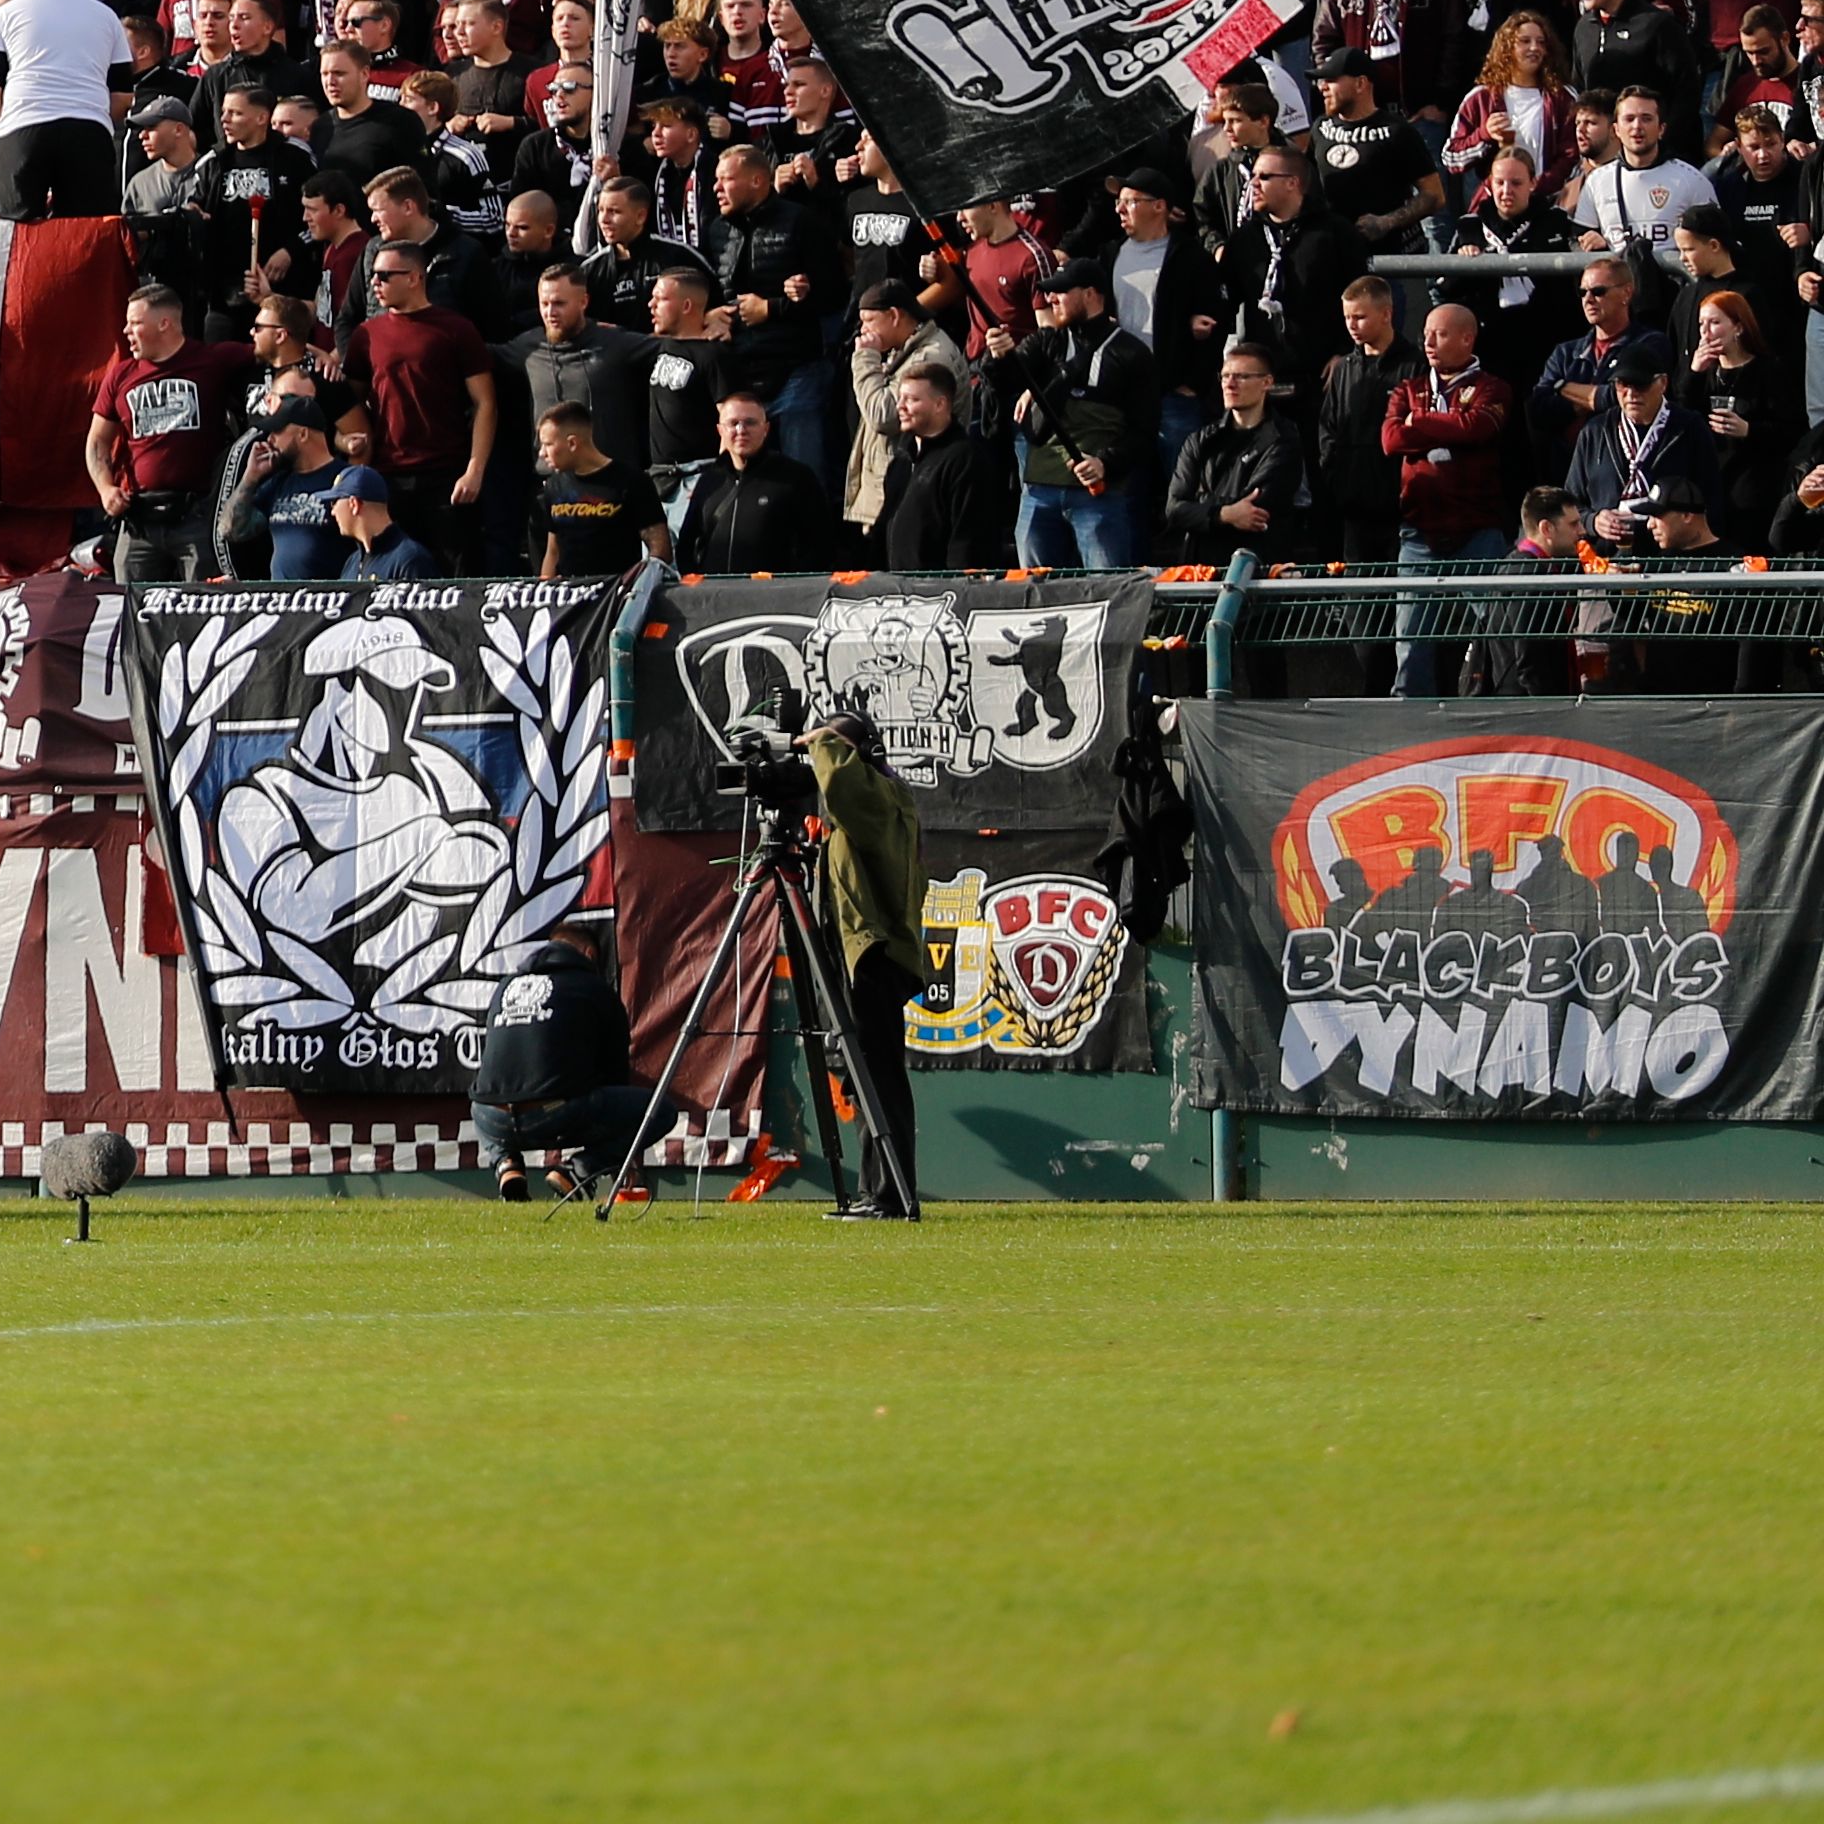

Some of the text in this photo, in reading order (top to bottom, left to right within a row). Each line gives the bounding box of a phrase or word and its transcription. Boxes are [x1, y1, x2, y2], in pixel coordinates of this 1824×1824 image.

[1327, 773, 1677, 895] BFC
[994, 890, 1108, 939] BFC
[927, 984, 950, 1002] 05
[1280, 927, 1731, 1001] BLACKBOYS
[1279, 1000, 1731, 1099] DYNAMO
